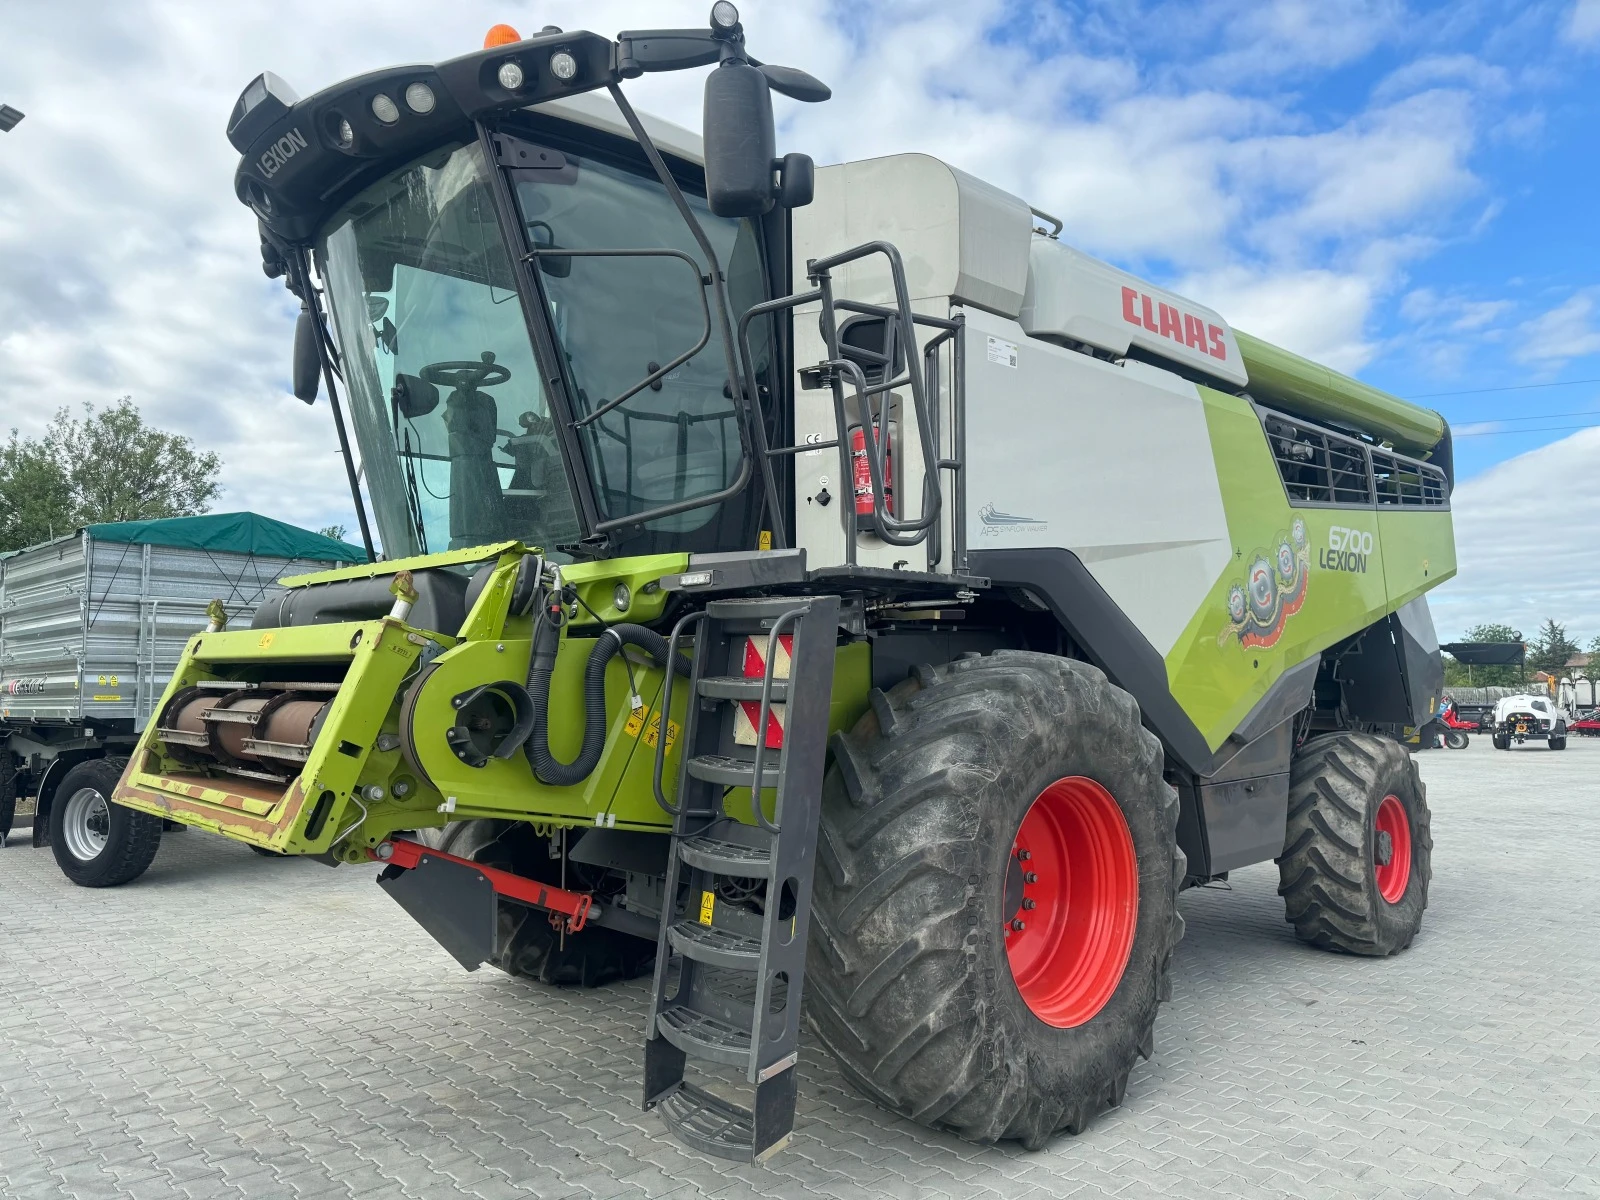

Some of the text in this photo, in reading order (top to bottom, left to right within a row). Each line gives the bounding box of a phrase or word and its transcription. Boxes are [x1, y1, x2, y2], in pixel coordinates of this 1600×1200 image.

[255, 127, 308, 179] LEXION
[1121, 285, 1226, 361] CLAAS
[980, 526, 999, 537] APS
[1027, 525, 1048, 533] WALKER
[1328, 525, 1373, 555] 6700
[1319, 547, 1367, 574] LEXION
